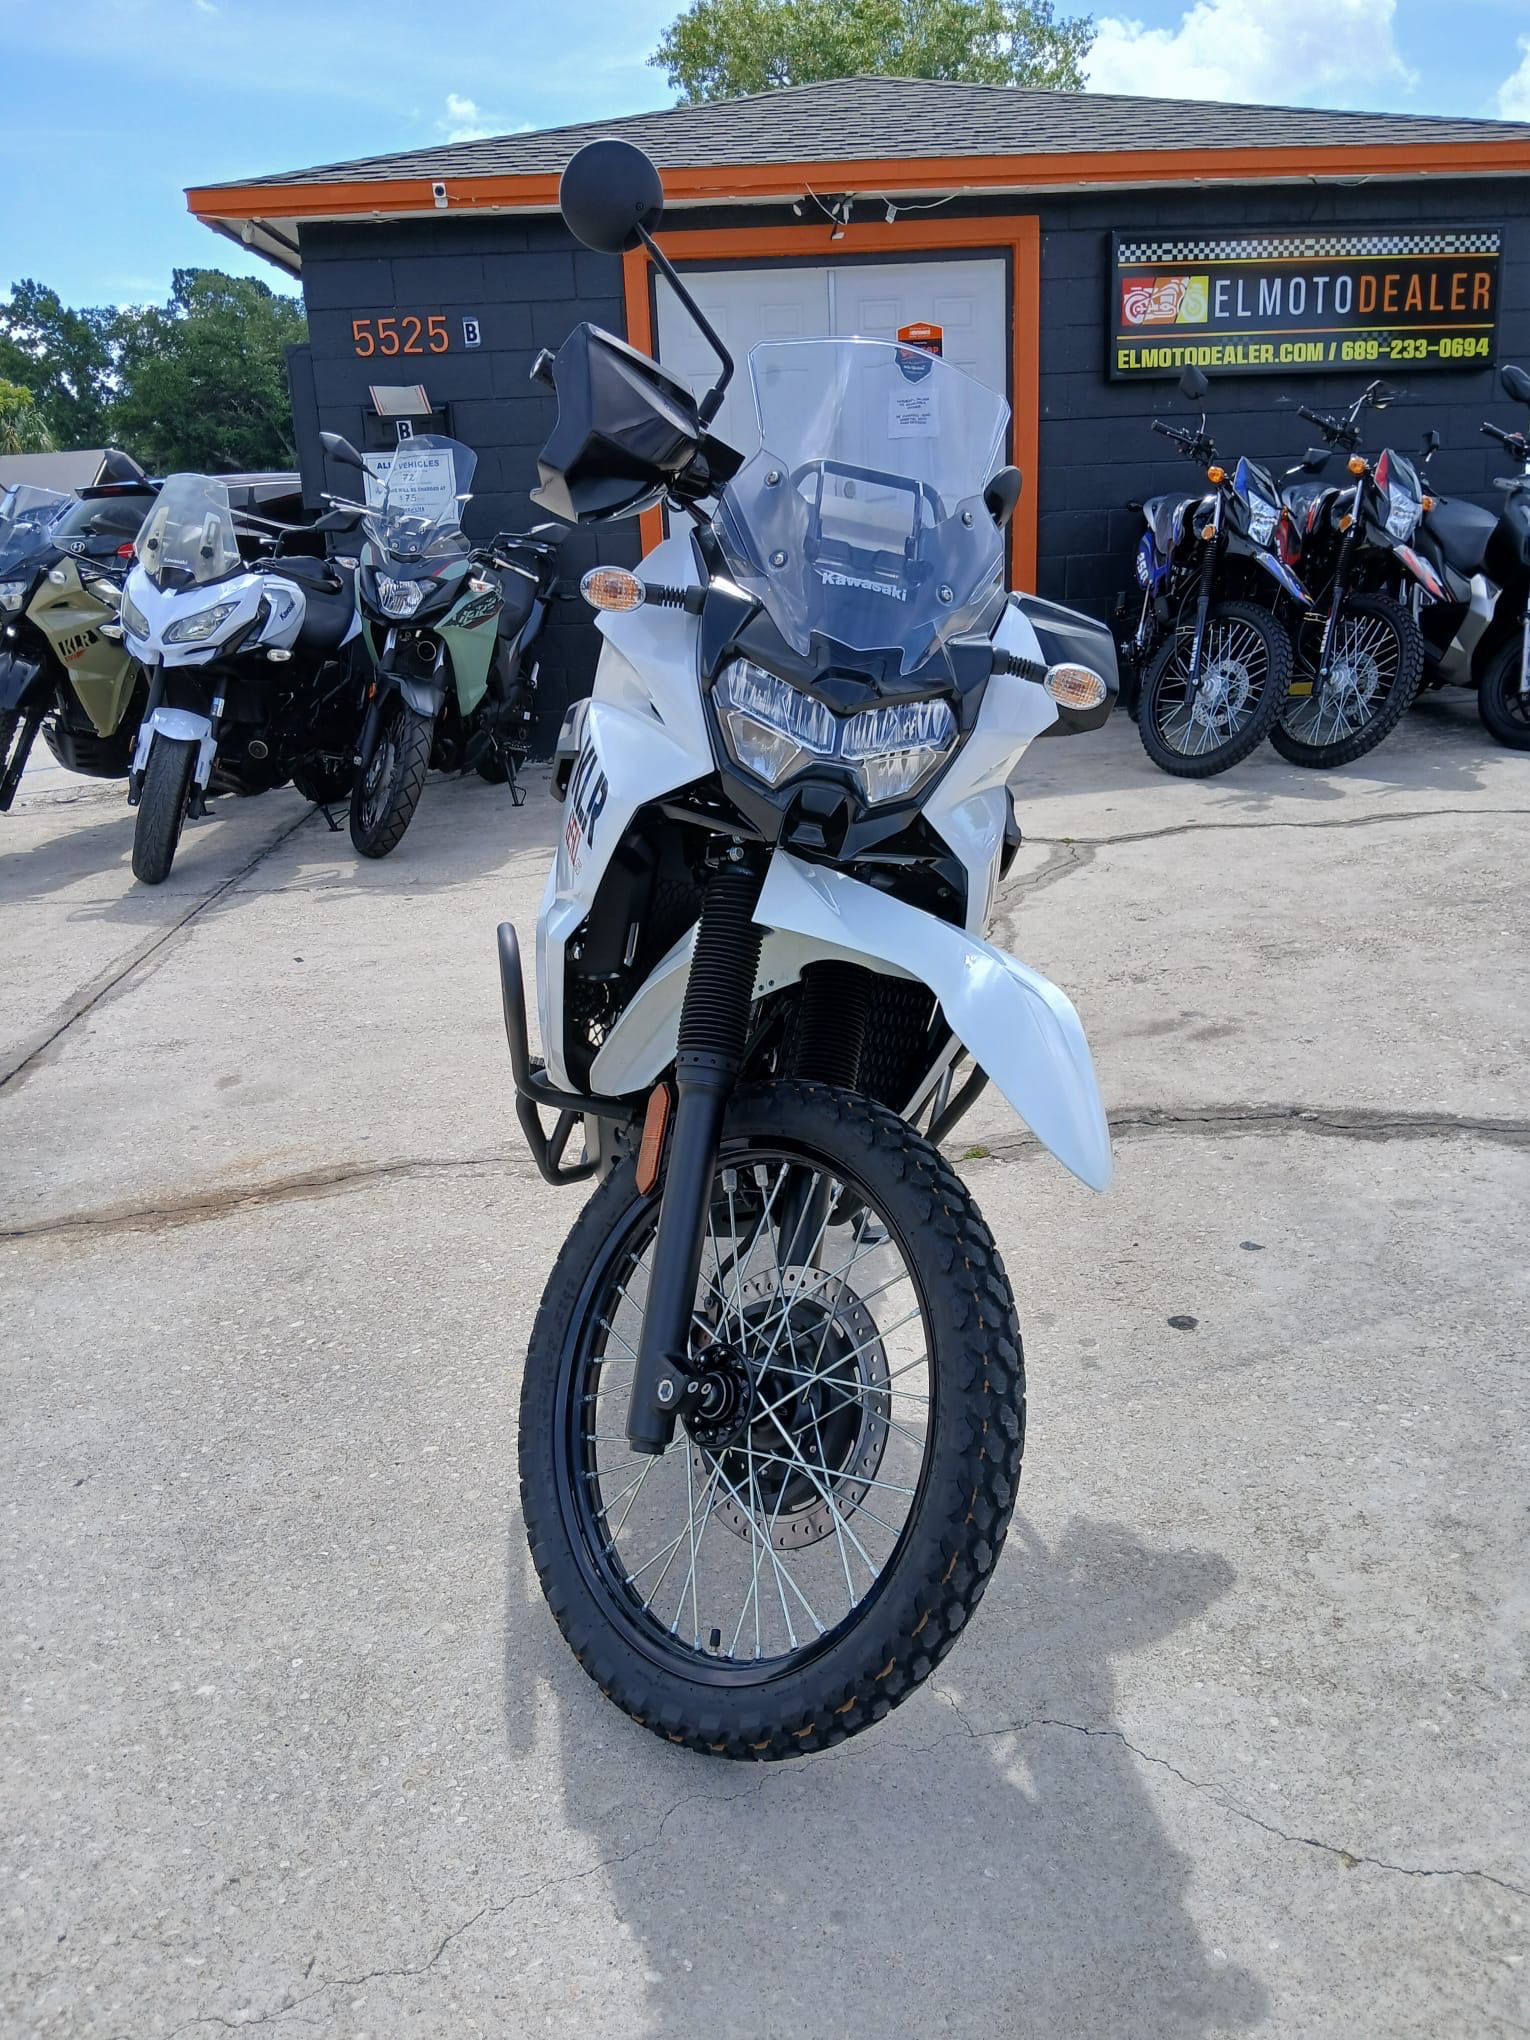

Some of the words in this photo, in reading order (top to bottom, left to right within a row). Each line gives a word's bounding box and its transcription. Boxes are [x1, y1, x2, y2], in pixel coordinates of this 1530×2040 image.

[1214, 272, 1491, 318] ELMOTODEALER
[352, 316, 450, 357] 5525
[465, 322, 478, 342] B
[1117, 342, 1324, 370] ELMOTODEALER.COM
[1341, 338, 1490, 361] 689-233-0694
[399, 422, 411, 440] B
[821, 571, 908, 602] Kawasaki
